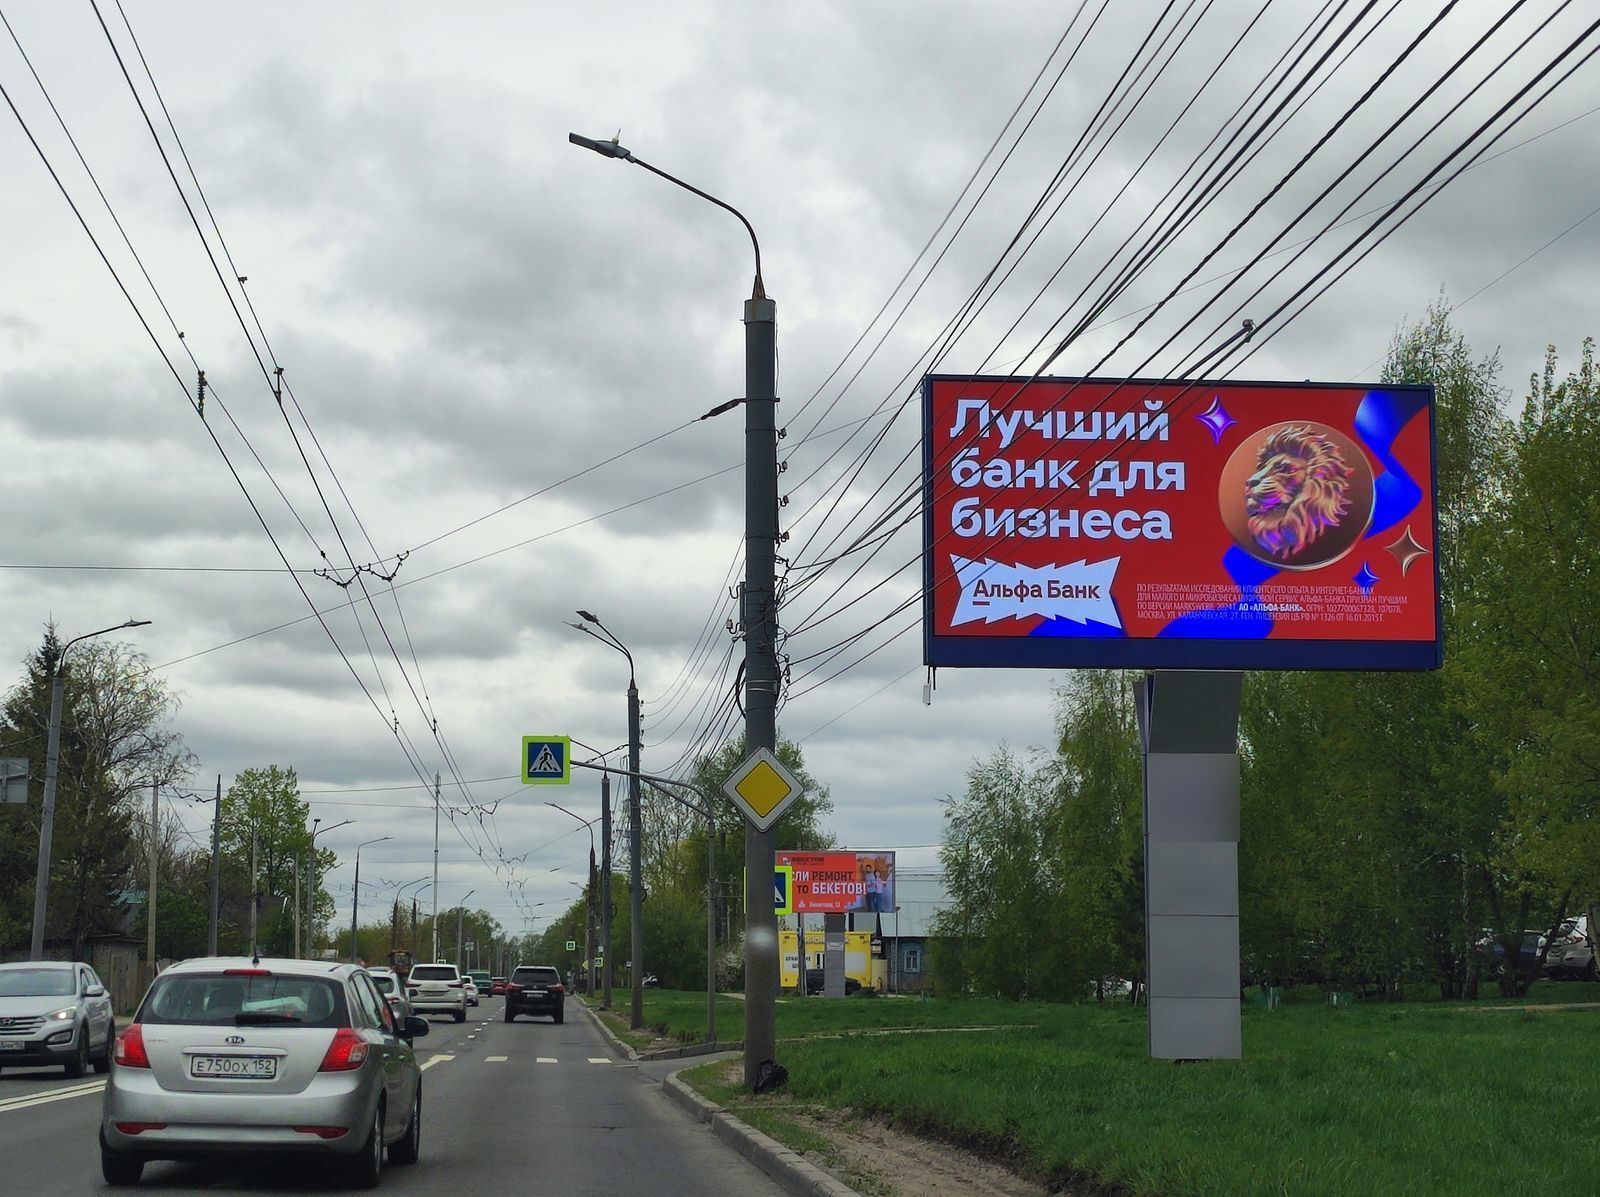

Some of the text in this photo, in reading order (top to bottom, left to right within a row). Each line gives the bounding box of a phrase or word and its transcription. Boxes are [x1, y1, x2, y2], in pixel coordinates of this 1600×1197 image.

[950, 400, 1169, 448] Лучший
[951, 447, 1185, 496] банк для
[951, 497, 1172, 540] бизнеса
[972, 579, 1101, 603] Альфа Банк
